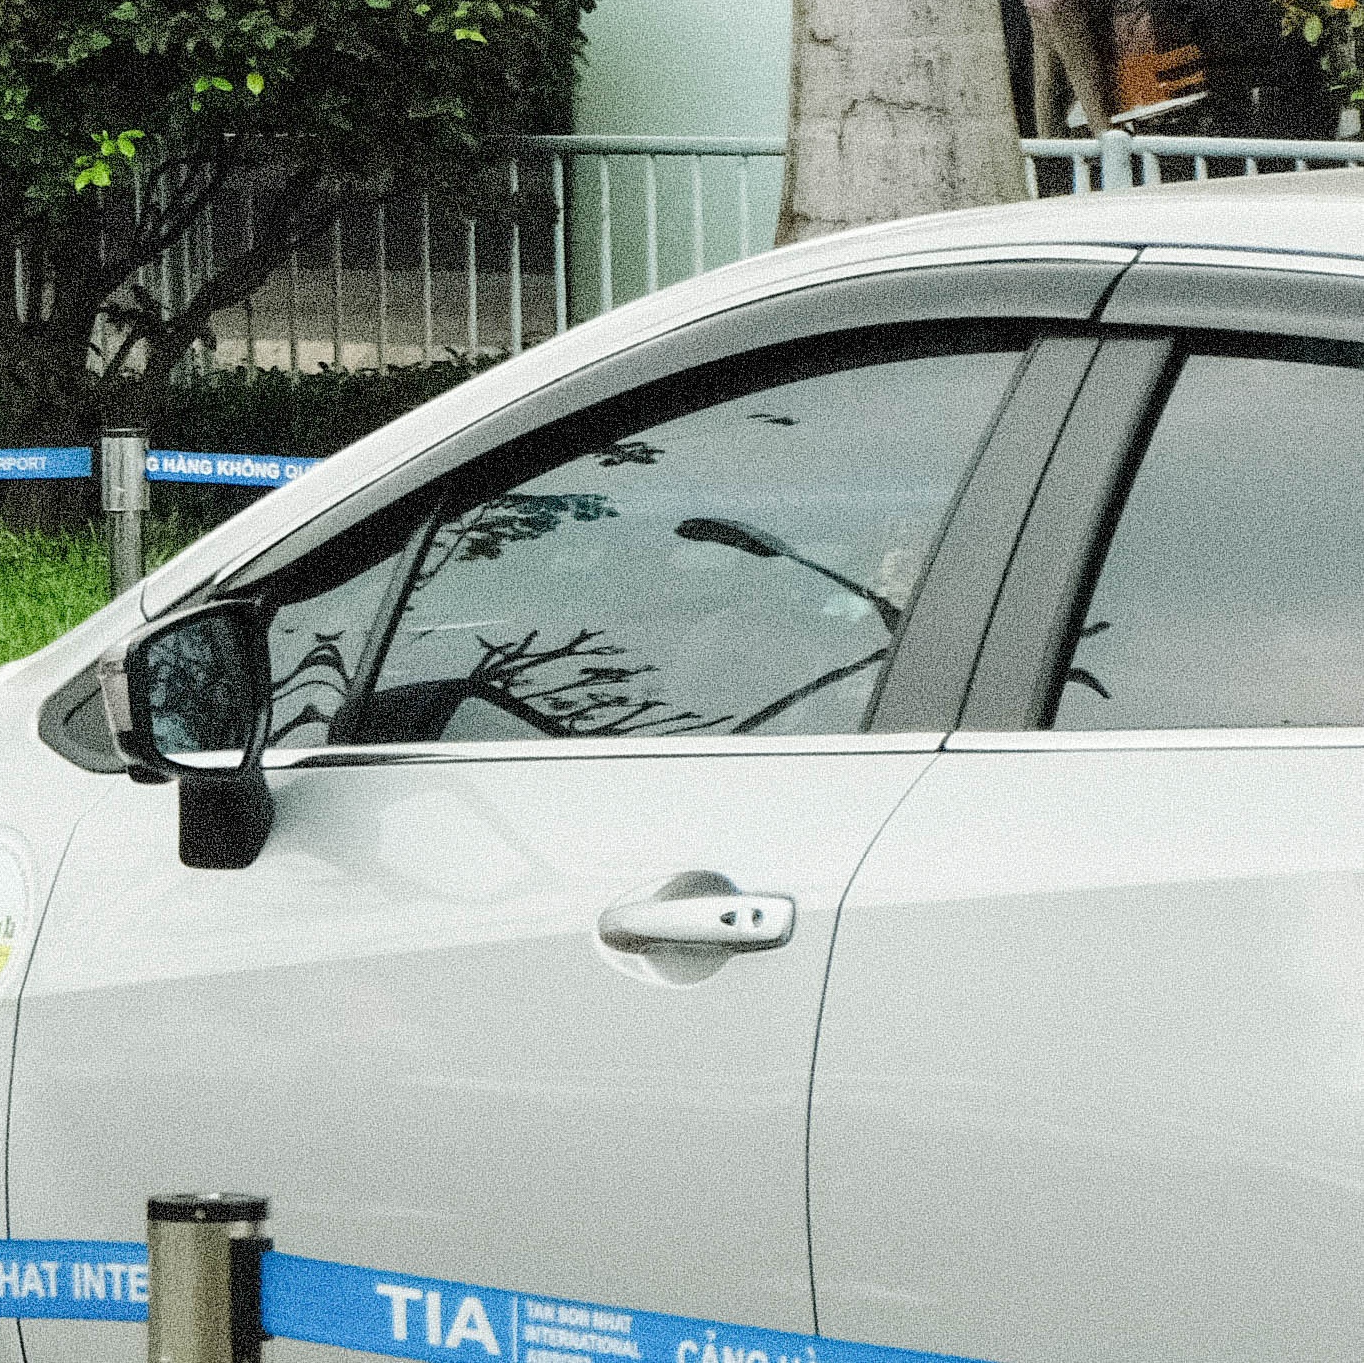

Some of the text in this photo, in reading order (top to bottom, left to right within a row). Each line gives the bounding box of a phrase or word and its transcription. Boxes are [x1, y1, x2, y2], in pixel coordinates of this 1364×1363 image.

[162, 455, 213, 476] HÀNG
[217, 458, 280, 479] KHÔNG
[73, 1261, 149, 1303] INTE
[376, 1282, 502, 1357] TIA
